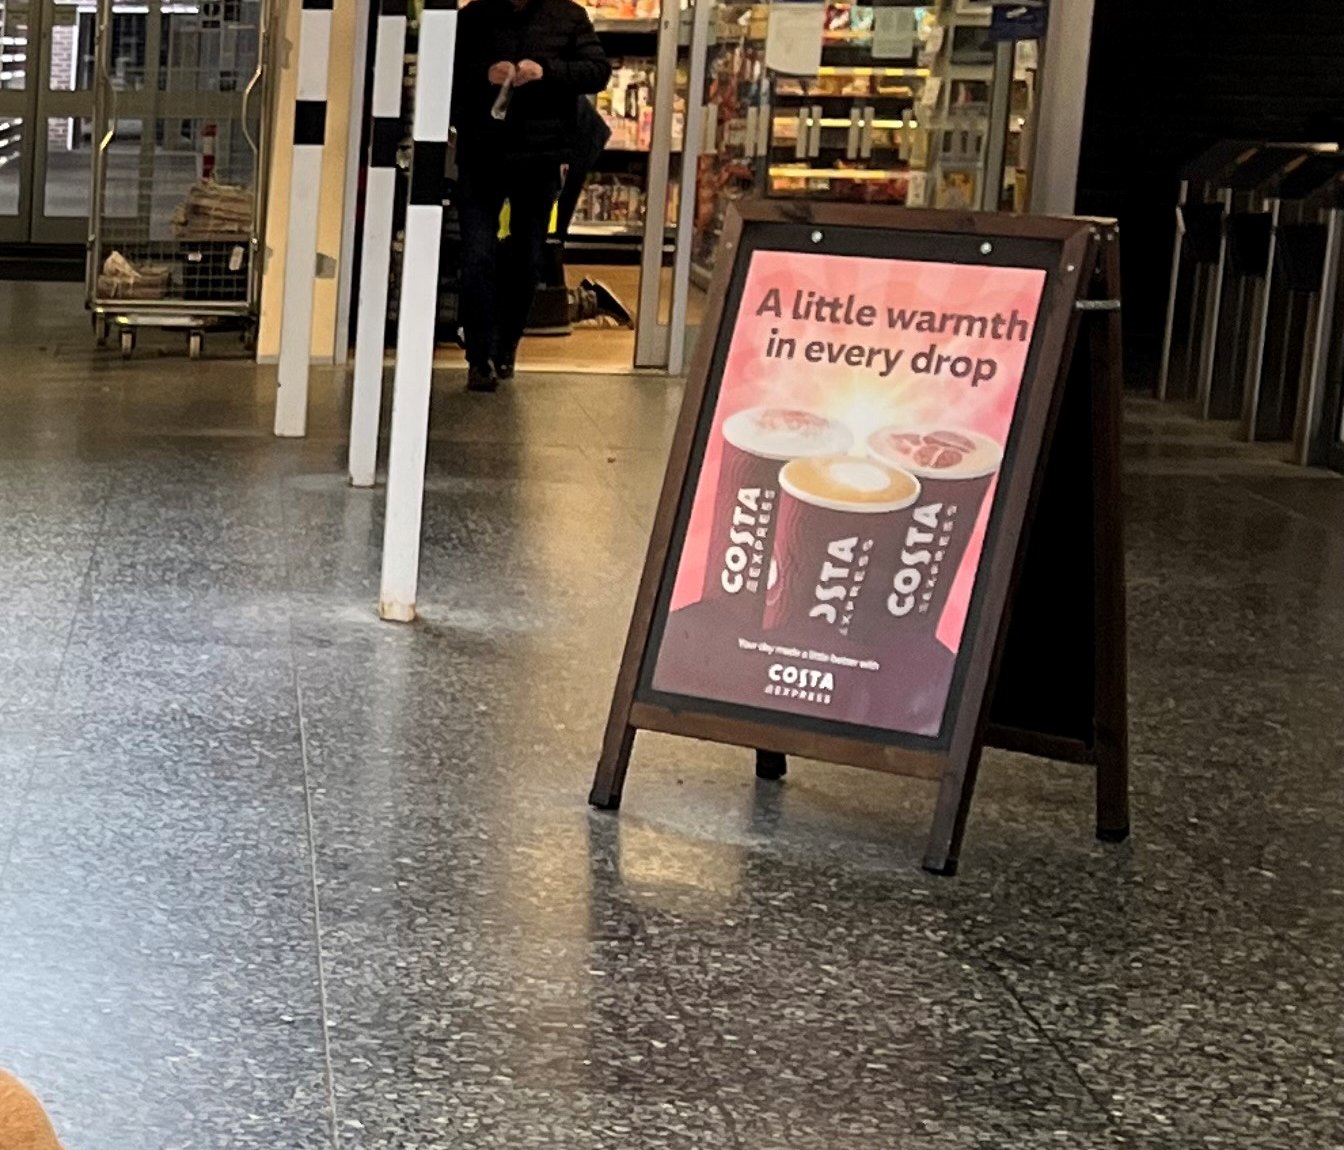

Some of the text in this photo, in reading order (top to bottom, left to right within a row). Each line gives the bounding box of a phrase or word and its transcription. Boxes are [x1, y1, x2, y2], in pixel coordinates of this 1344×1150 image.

[756, 288, 1029, 342] A little warmth
[766, 328, 997, 388] in every drop
[721, 488, 761, 593] COSTA
[887, 502, 943, 616] COSTA
[768, 664, 834, 691] COSTA
